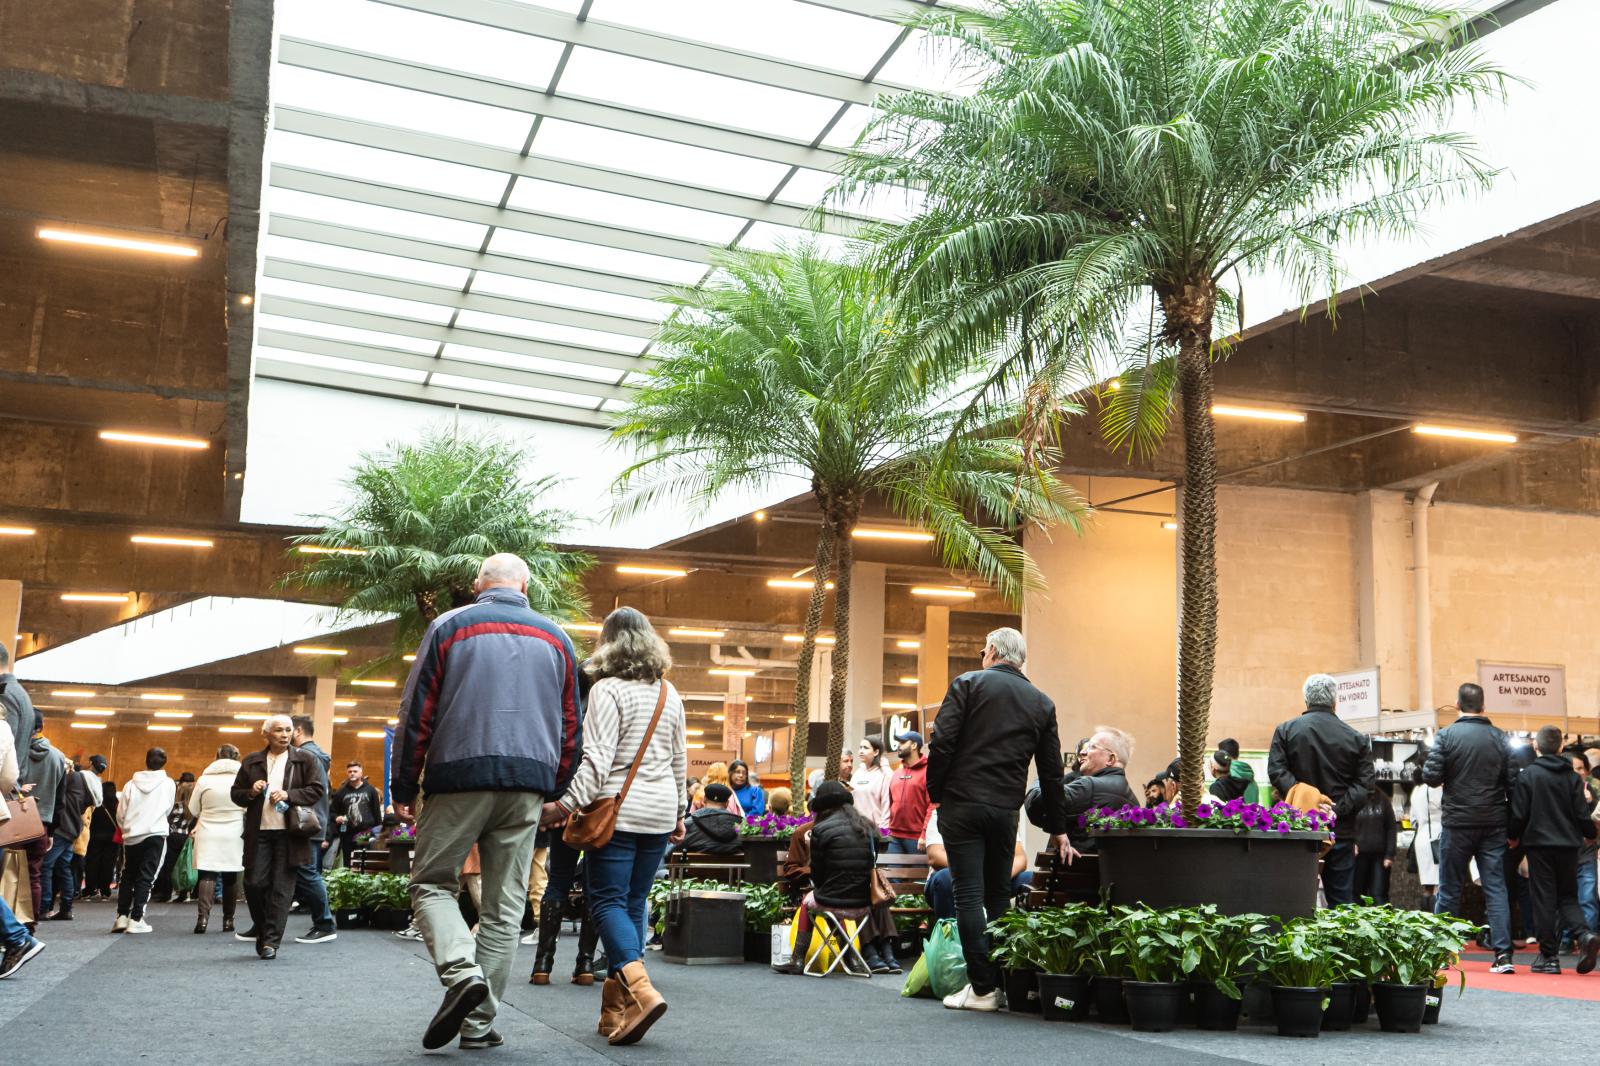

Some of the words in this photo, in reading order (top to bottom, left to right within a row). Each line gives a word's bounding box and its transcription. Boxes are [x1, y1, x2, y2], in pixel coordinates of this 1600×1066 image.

[1494, 674, 1550, 684] ARTESANATO
[1348, 691, 1368, 701] VIDROS
[1498, 686, 1512, 694] EM
[1514, 686, 1546, 696] VIDROS
